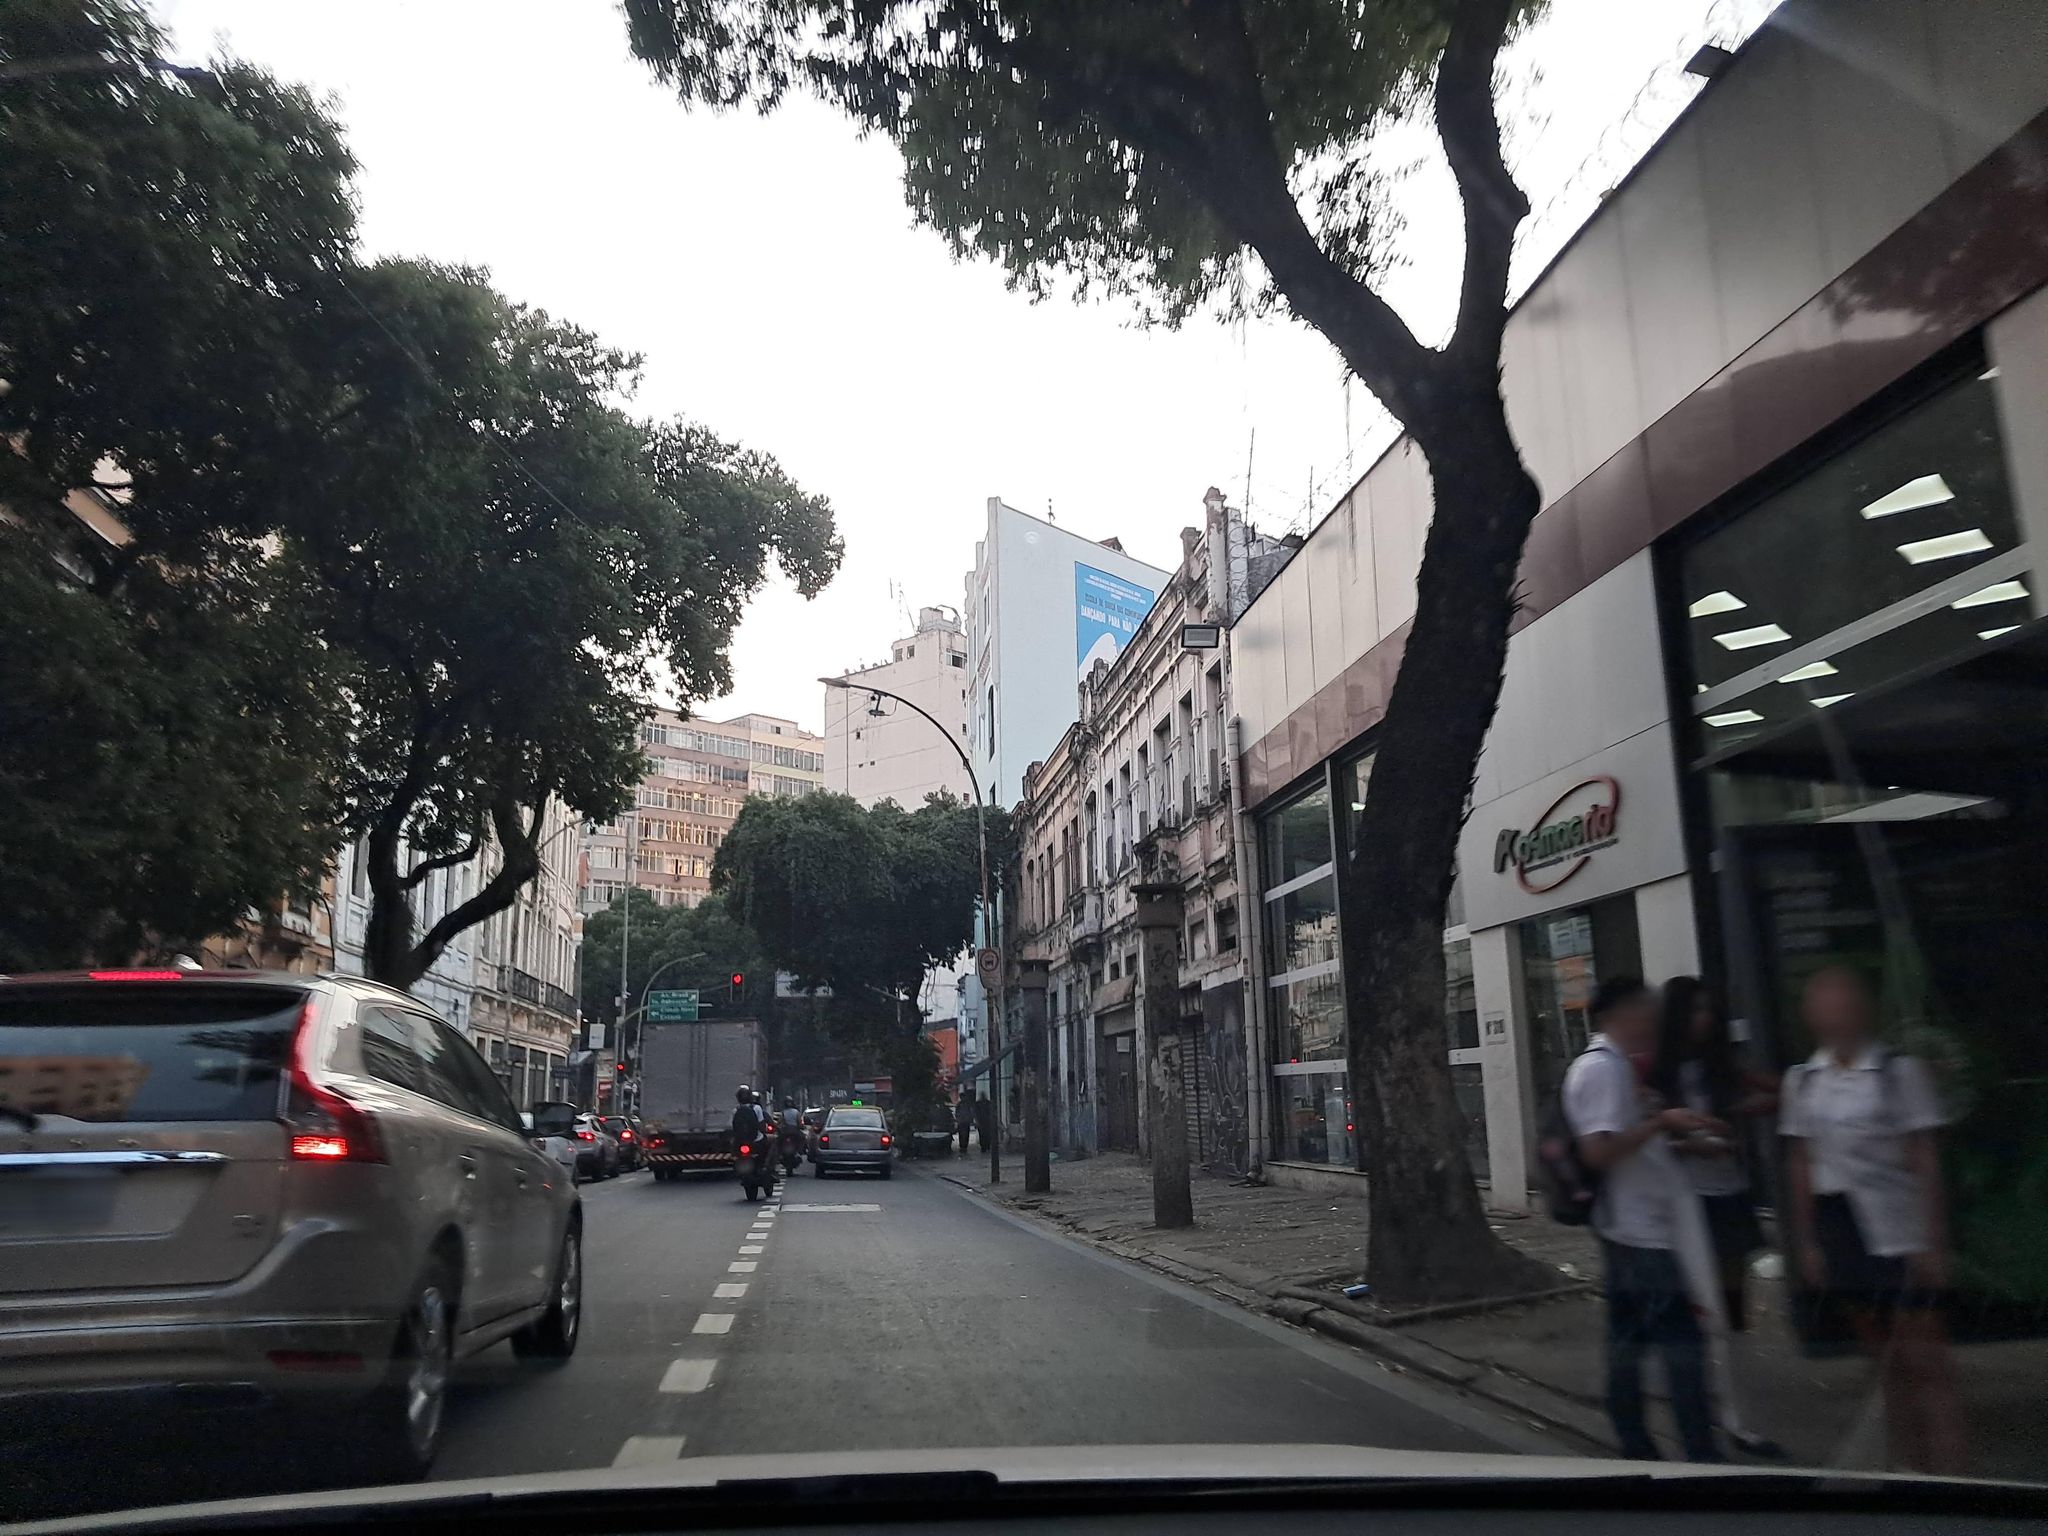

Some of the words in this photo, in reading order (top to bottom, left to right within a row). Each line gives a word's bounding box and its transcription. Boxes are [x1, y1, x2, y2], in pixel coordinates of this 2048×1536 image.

[1081, 605, 1106, 623] DANÇANDO
[1108, 614, 1121, 629] PARA
[1122, 617, 1132, 633] NÃO
